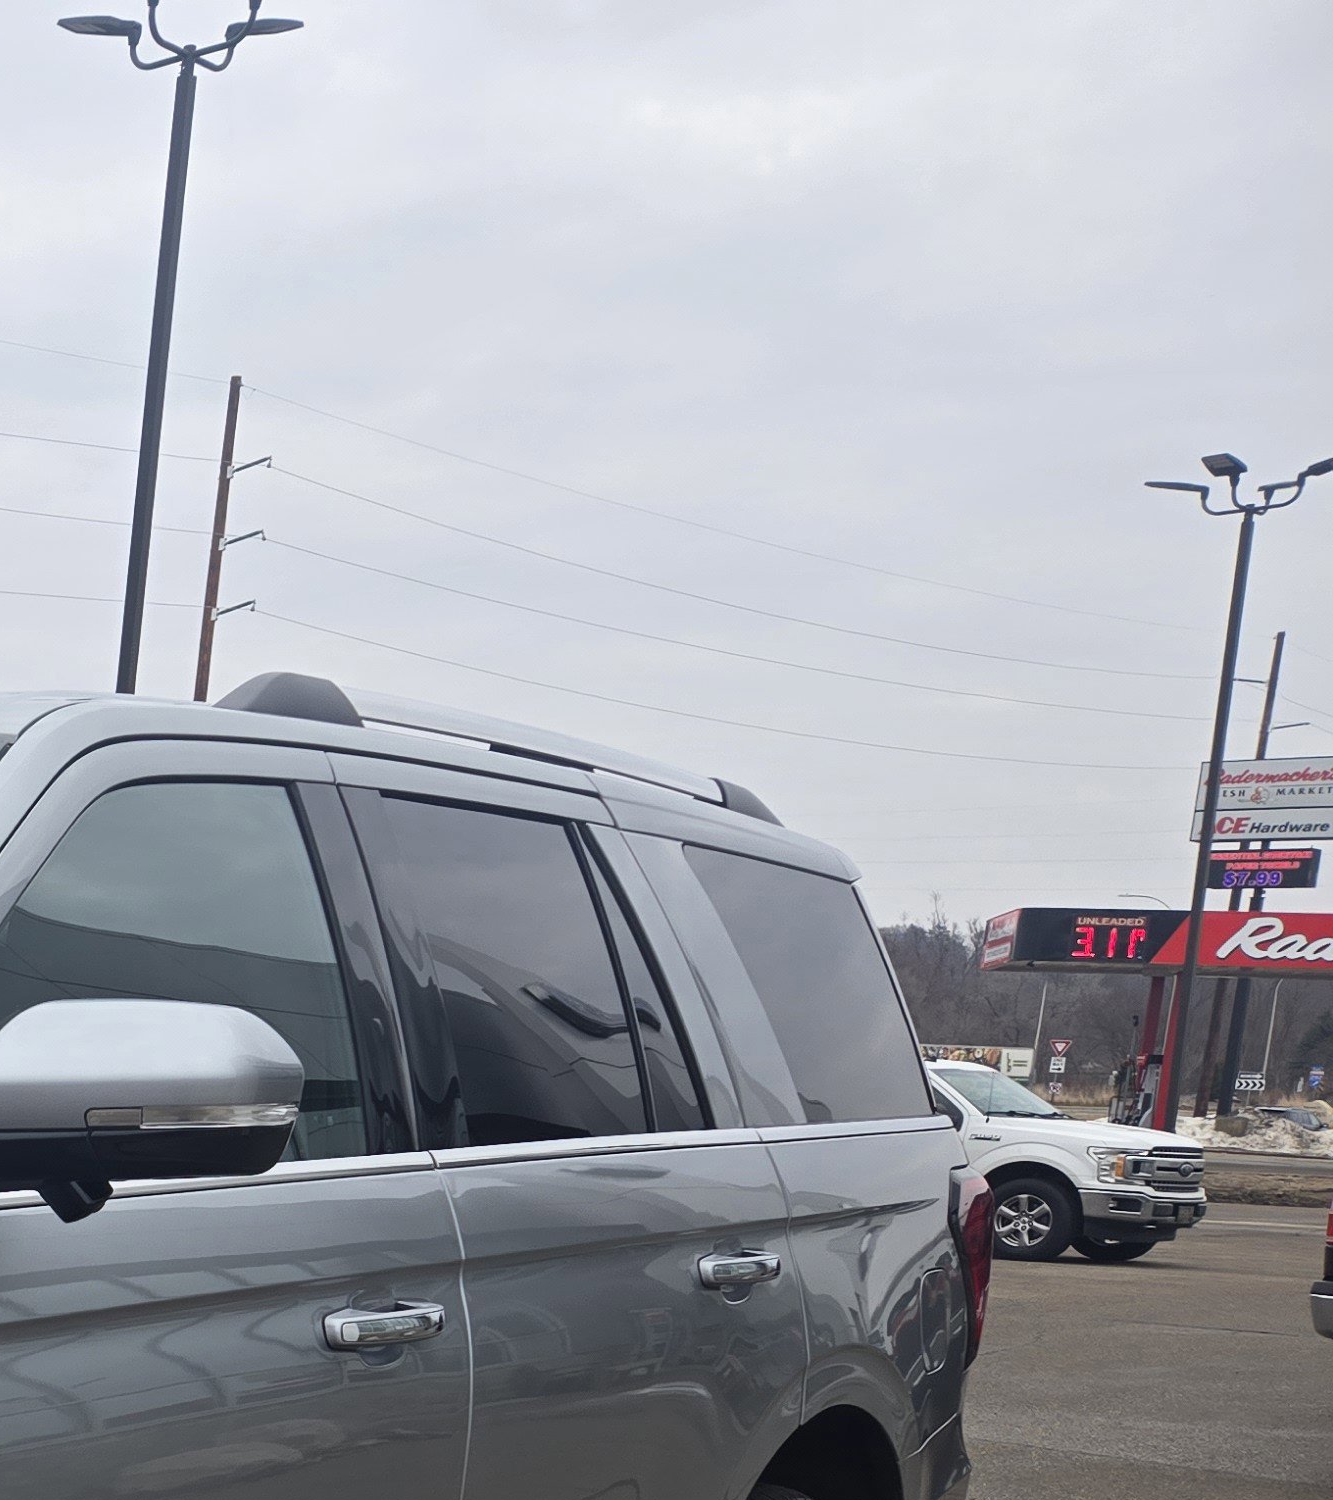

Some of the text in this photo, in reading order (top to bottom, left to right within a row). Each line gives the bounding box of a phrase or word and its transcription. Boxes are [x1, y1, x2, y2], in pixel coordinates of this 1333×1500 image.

[1249, 821, 1330, 834] Hardware
[1222, 871, 1283, 887] $7.99
[1077, 916, 1144, 926] UNLEADED
